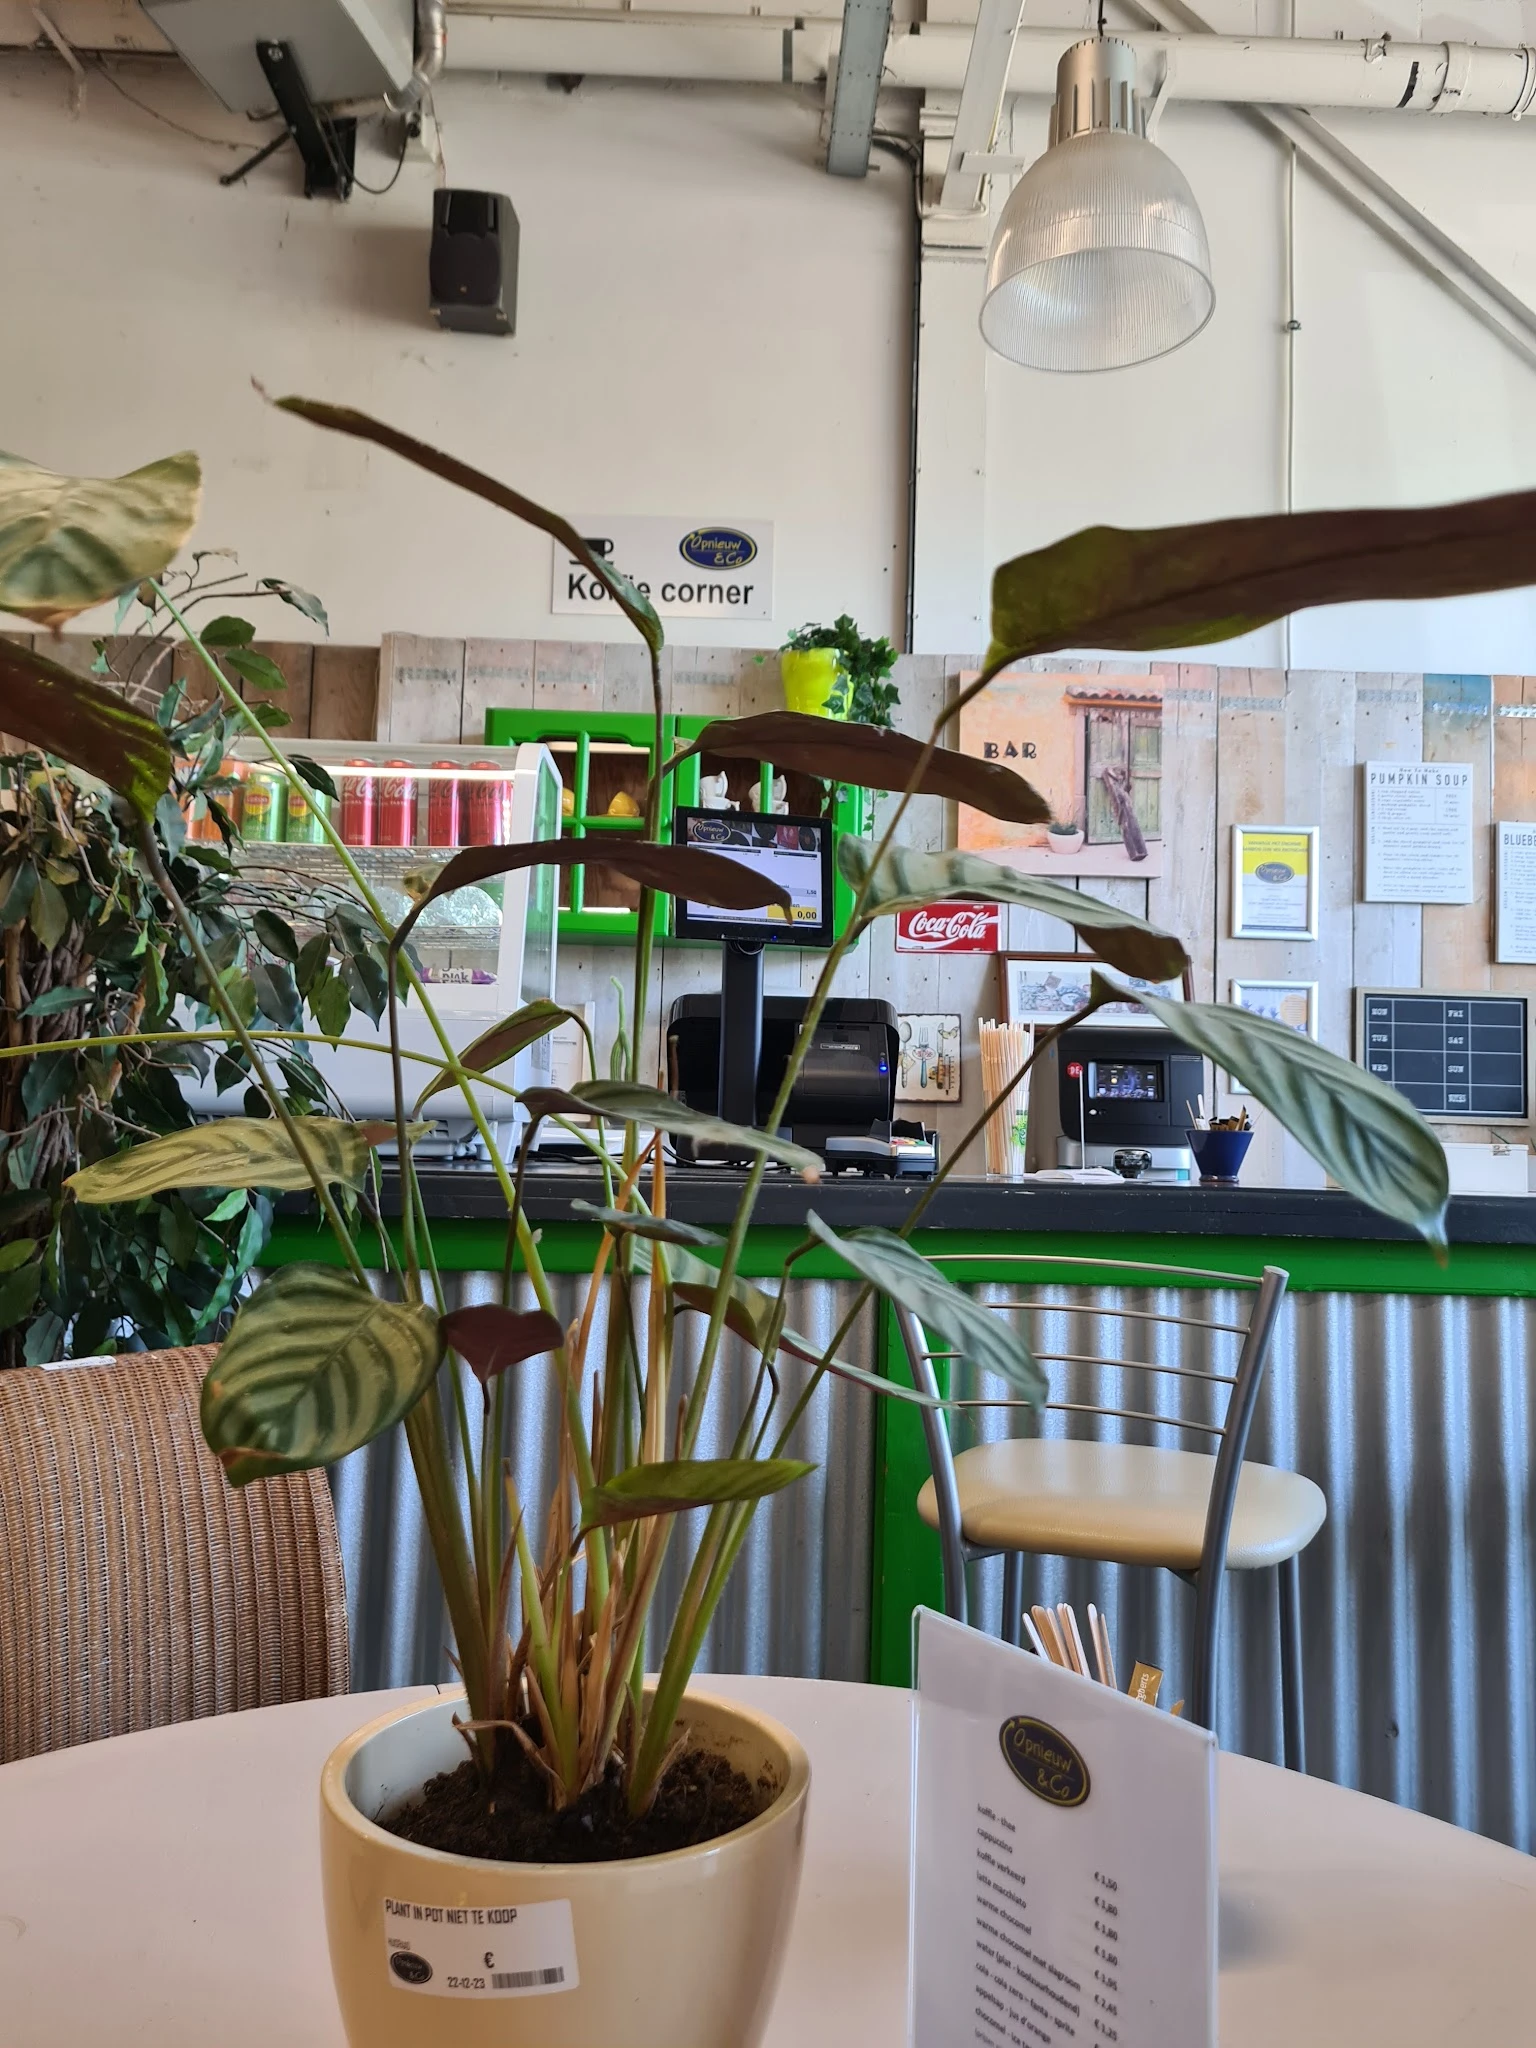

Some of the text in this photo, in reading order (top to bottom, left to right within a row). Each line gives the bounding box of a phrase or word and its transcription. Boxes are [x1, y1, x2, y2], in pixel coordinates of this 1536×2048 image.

[568, 573, 753, 604] Koe corner
[983, 741, 1037, 759] BAR
[1370, 773, 1468, 786] PUMPKIN SOUP
[797, 910, 817, 920] 0,00
[1371, 1008, 1388, 1016] MON
[1447, 1009, 1464, 1018] FRI
[1371, 1034, 1388, 1042] TUE
[1447, 1036, 1464, 1045] SAT
[1371, 1064, 1388, 1072] WED
[1447, 1065, 1464, 1073] SUN
[1014, 1728, 1072, 1773] Opnieuw
[1001, 1817, 1016, 1833] thee
[1101, 1875, 1118, 1891] 1,50
[385, 1899, 518, 1925] PLANT IN POT NIET TE KOOP
[999, 1909, 1032, 1936] chocomel
[484, 1952, 495, 1968] €
[447, 1976, 486, 1989] 22-12-23
